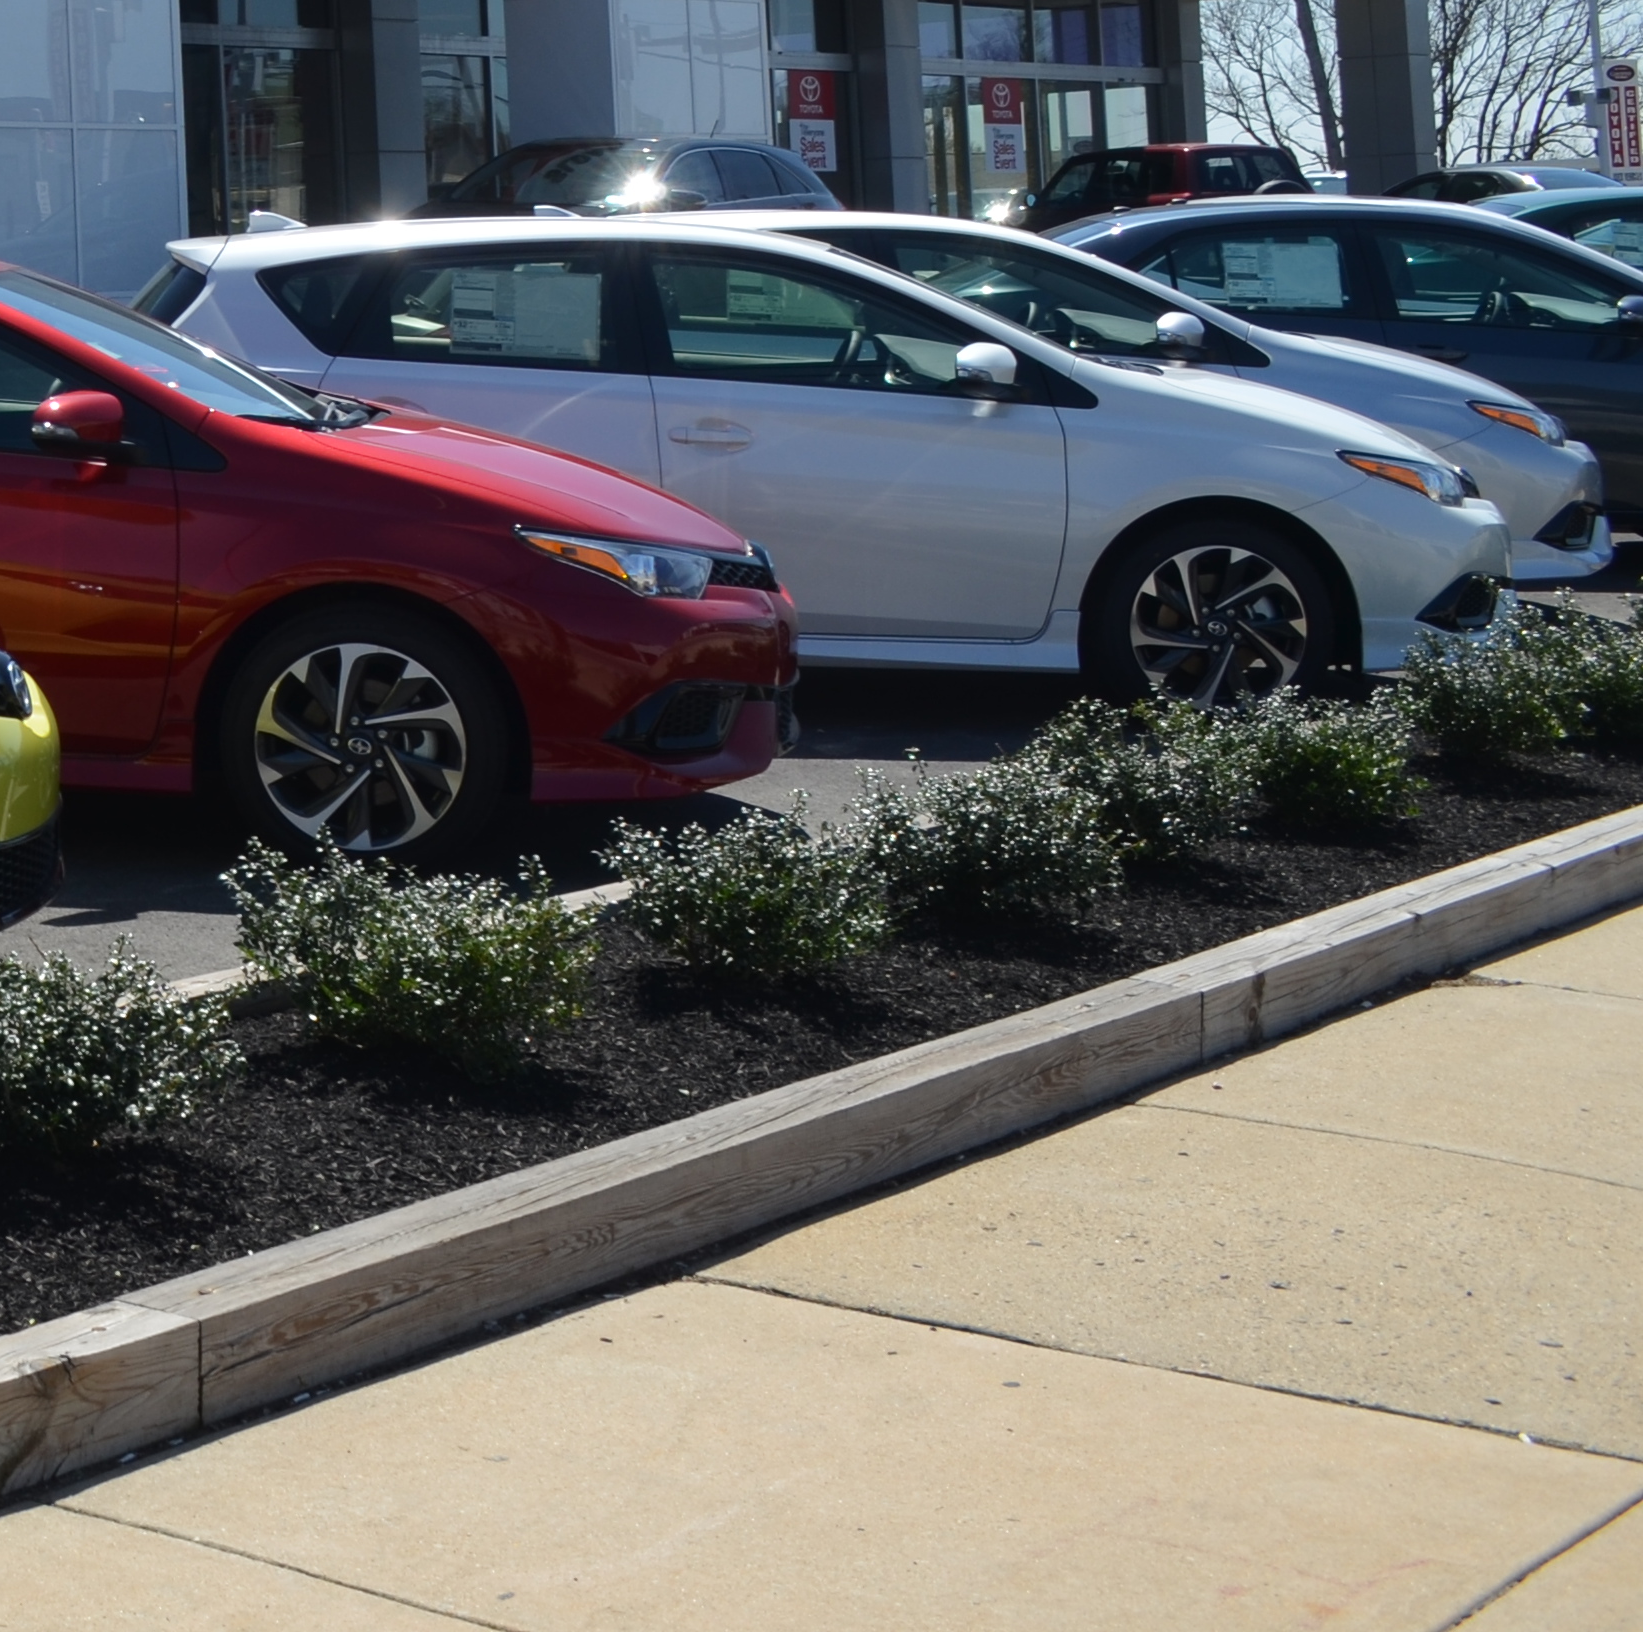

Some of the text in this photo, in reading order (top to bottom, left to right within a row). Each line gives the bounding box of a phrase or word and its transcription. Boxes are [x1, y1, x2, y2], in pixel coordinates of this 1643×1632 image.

[799, 105, 823, 114] TOYOTA
[992, 110, 1014, 119] TOYOTA
[1610, 102, 1623, 164] OYOTA
[1626, 89, 1640, 164] CERTIFIED
[800, 136, 826, 153] Sales
[993, 140, 1016, 156] Sales
[994, 155, 1017, 170] Event
